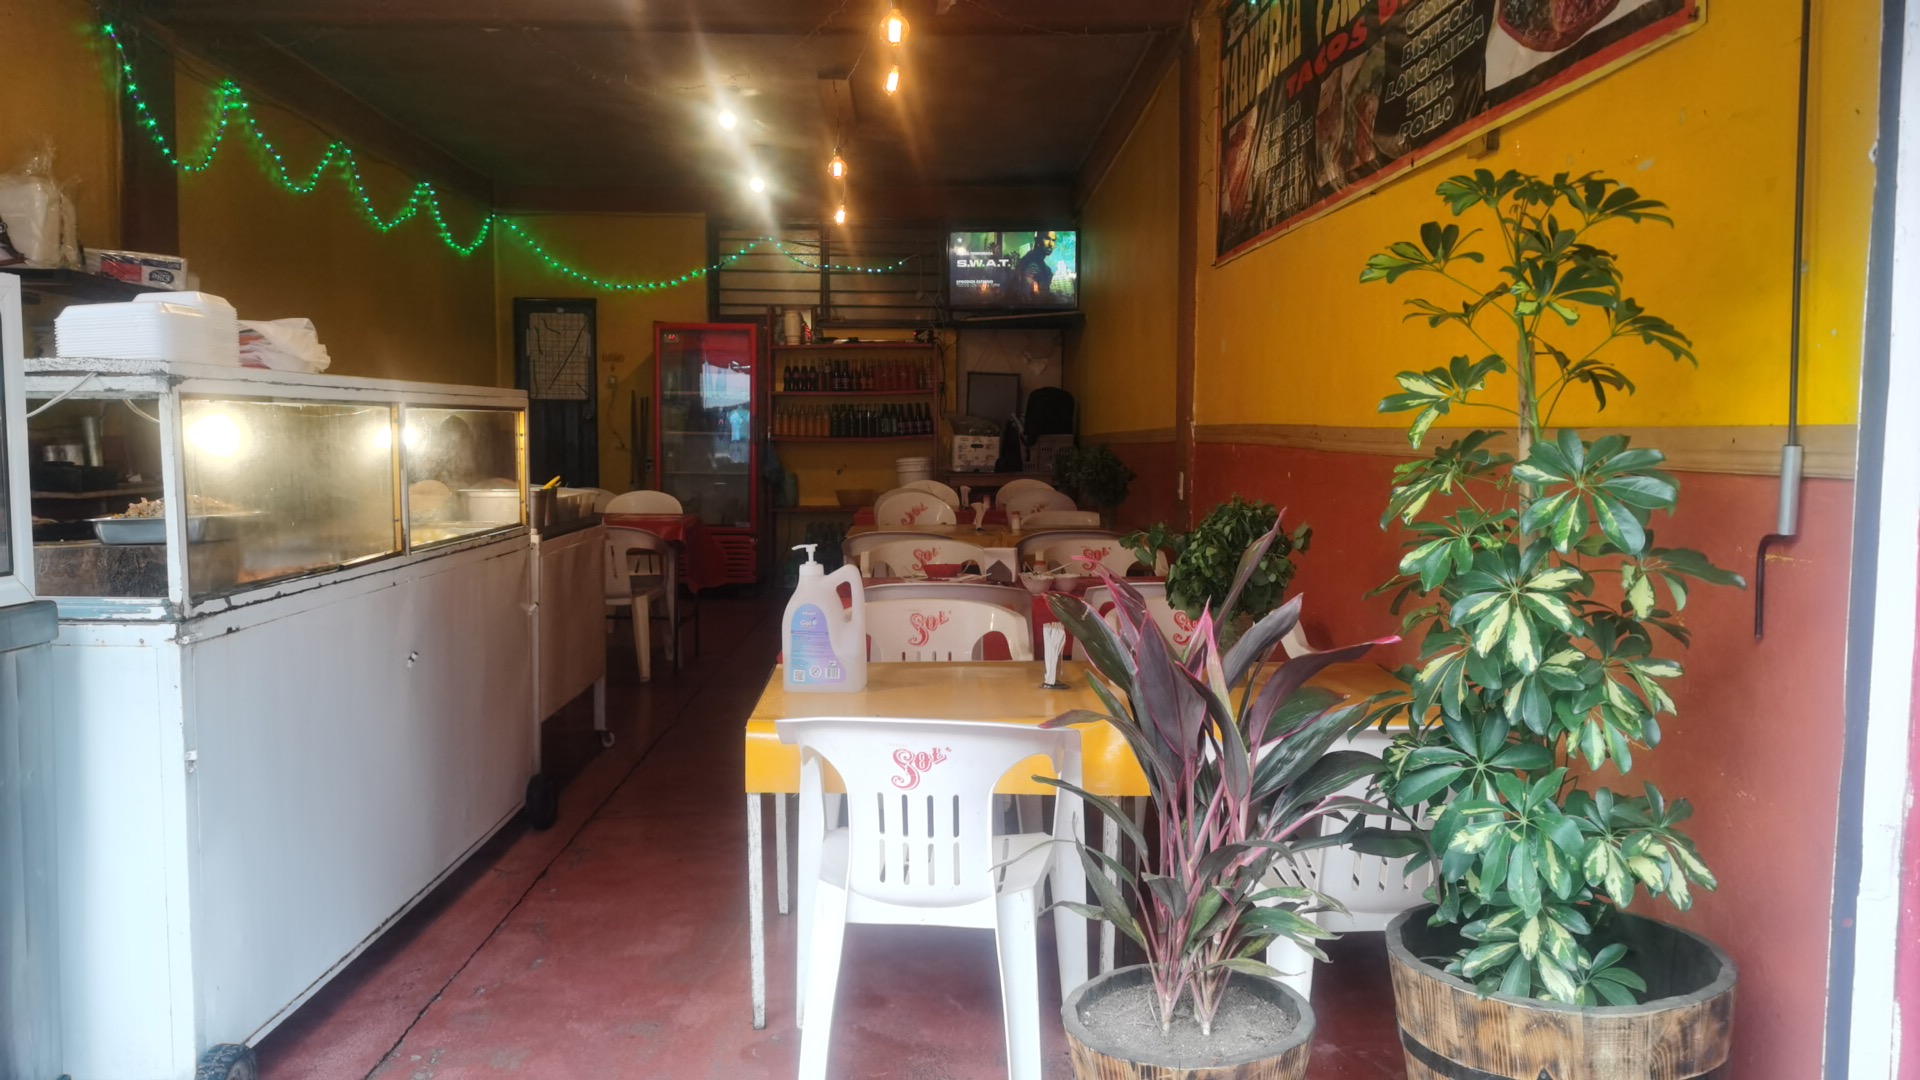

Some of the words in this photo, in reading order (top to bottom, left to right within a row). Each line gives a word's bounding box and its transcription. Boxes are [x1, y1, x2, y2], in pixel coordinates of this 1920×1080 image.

[1286, 15, 1368, 99] TACOS
[1378, 0, 1412, 25] D
[1384, 15, 1485, 104] LONGANIZA
[1406, 65, 1455, 117] TRIPA
[1398, 96, 1455, 146] POLLO
[956, 259, 1011, 268] S.W.A.T.
